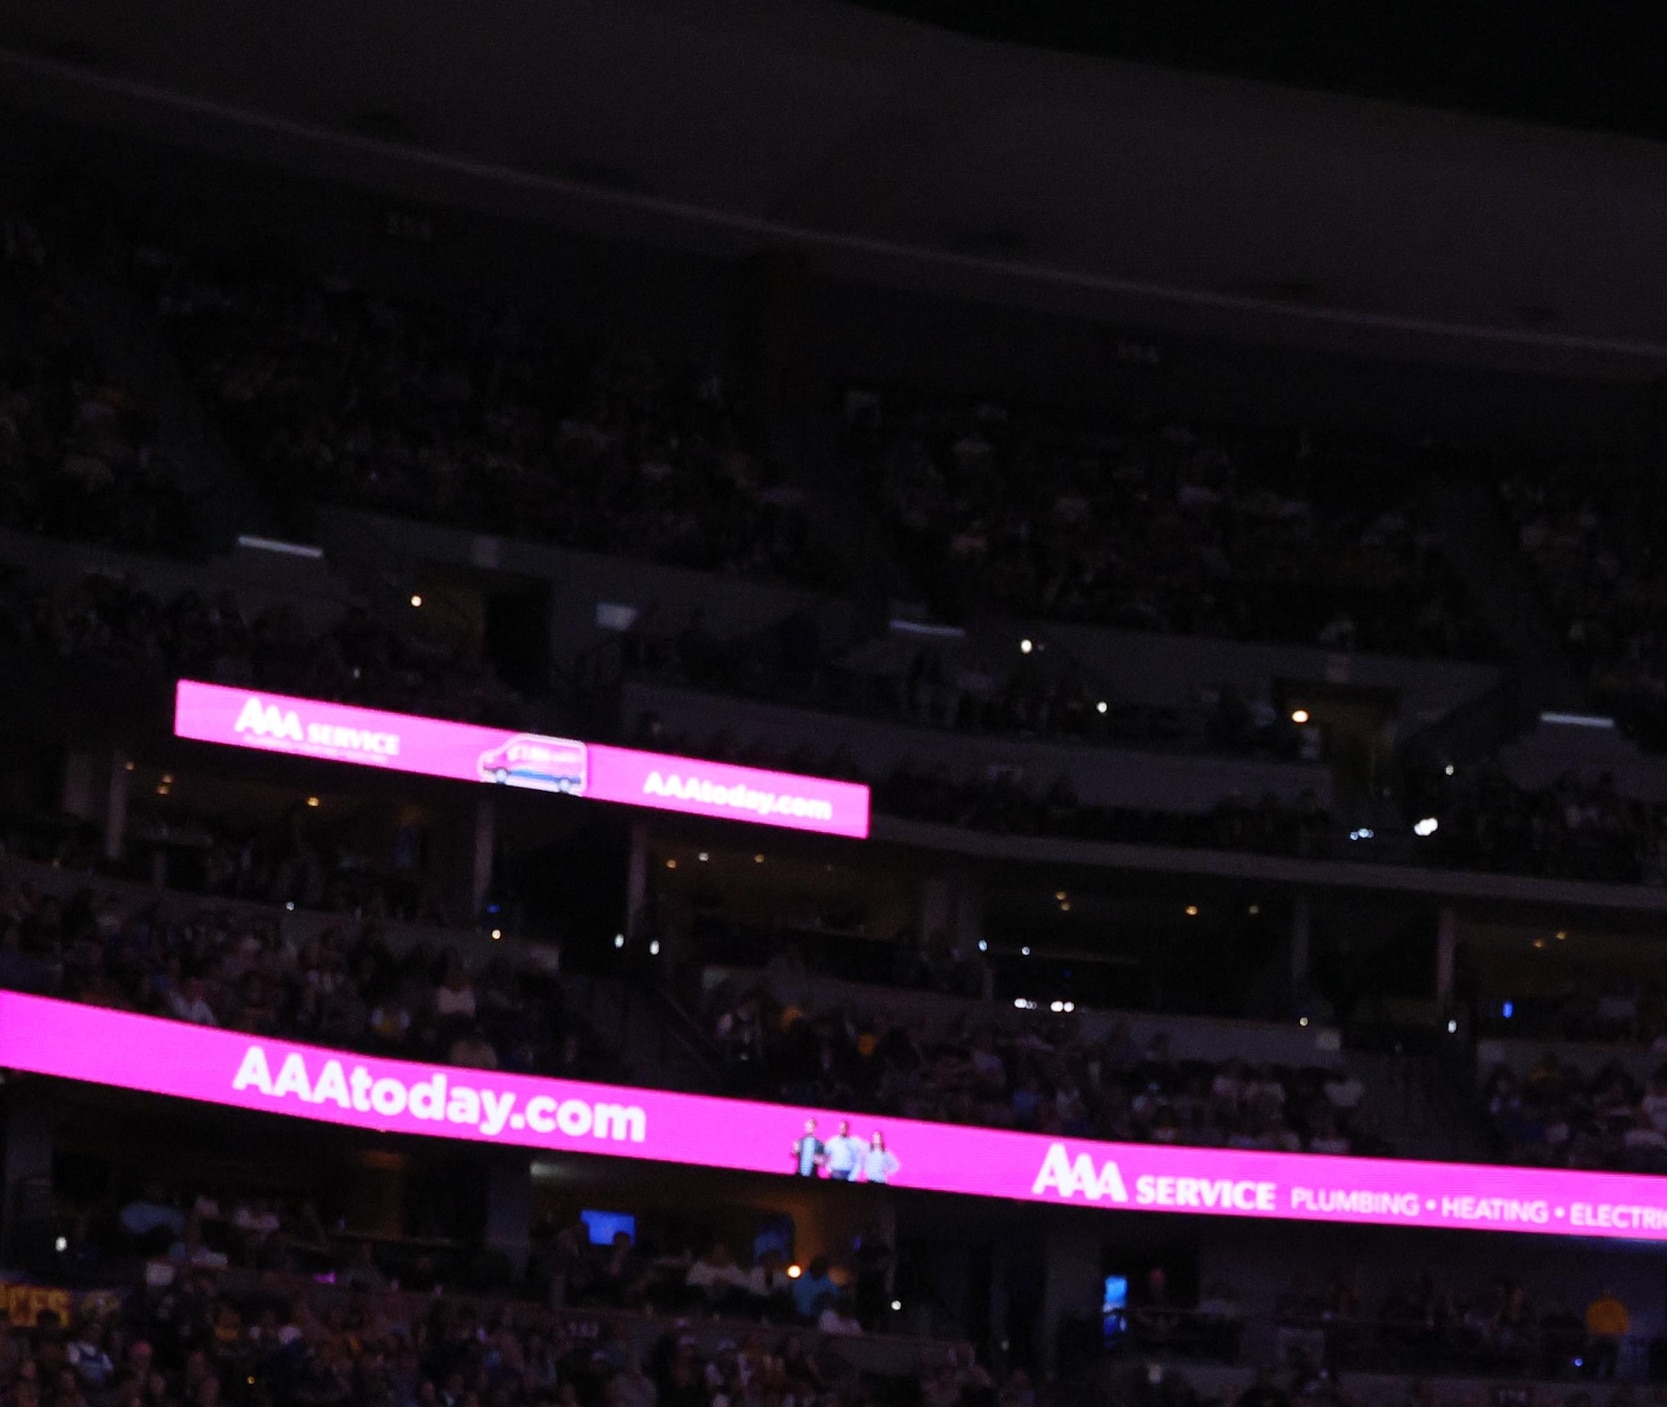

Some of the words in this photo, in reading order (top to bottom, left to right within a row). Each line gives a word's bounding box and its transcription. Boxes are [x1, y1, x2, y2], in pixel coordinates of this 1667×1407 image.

[234, 698, 303, 740] AAA
[307, 722, 400, 757] SERVICE
[642, 771, 832, 822] AAAtoday.com
[231, 1045, 647, 1144] AAAtoday.com
[1032, 1142, 1128, 1202] AAA
[1136, 1174, 1276, 1212] SERVICE
[1290, 1186, 1420, 1217] PLUMBING
[1441, 1196, 1549, 1225] HEATING
